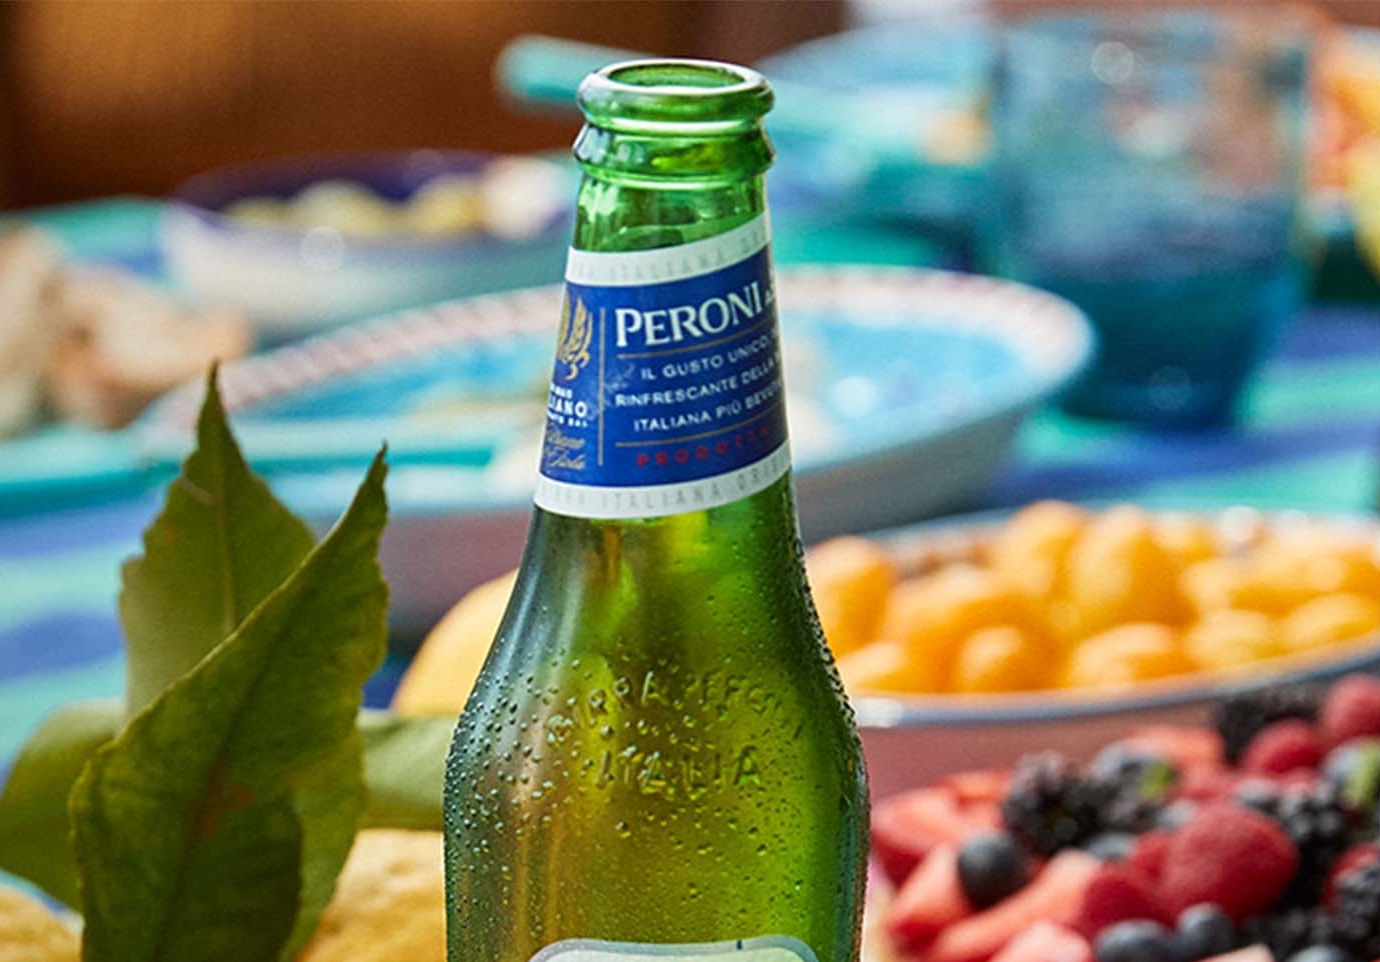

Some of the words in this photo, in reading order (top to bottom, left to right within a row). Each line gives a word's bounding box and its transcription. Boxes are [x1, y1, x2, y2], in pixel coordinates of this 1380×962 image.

[615, 281, 762, 348] PERONI
[640, 367, 657, 381] IL
[662, 354, 724, 378] GUSTO
[614, 375, 739, 407] RINFRESCANTE
[633, 410, 713, 433] ITALIANA
